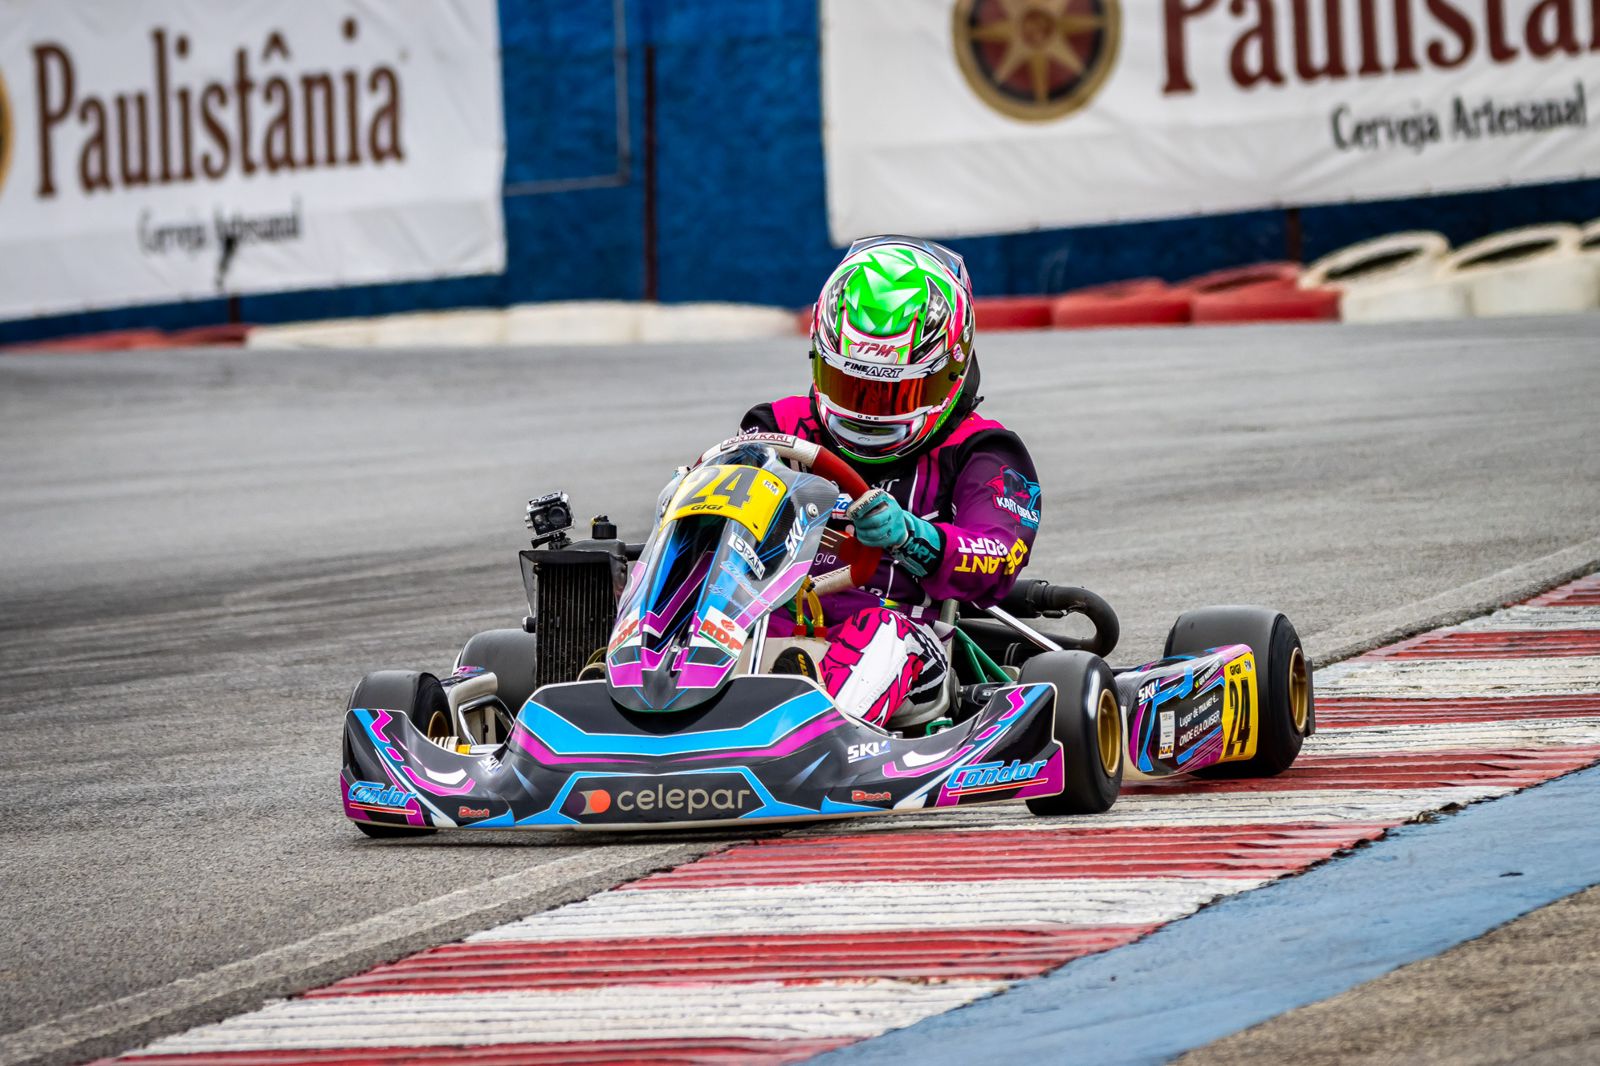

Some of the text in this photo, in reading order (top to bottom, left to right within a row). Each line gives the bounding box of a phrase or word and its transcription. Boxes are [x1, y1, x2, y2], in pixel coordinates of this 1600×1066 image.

[32, 17, 407, 200] Paulistânia
[1331, 80, 1588, 154] Cerveja Artesanal
[857, 341, 895, 358] TPM
[675, 467, 760, 510] 24
[690, 503, 724, 511] GIGI
[701, 618, 744, 651] RDP
[1225, 678, 1251, 757] 24
[946, 759, 1048, 789] Condor
[348, 780, 417, 807] Condor
[617, 784, 750, 815] celepar
